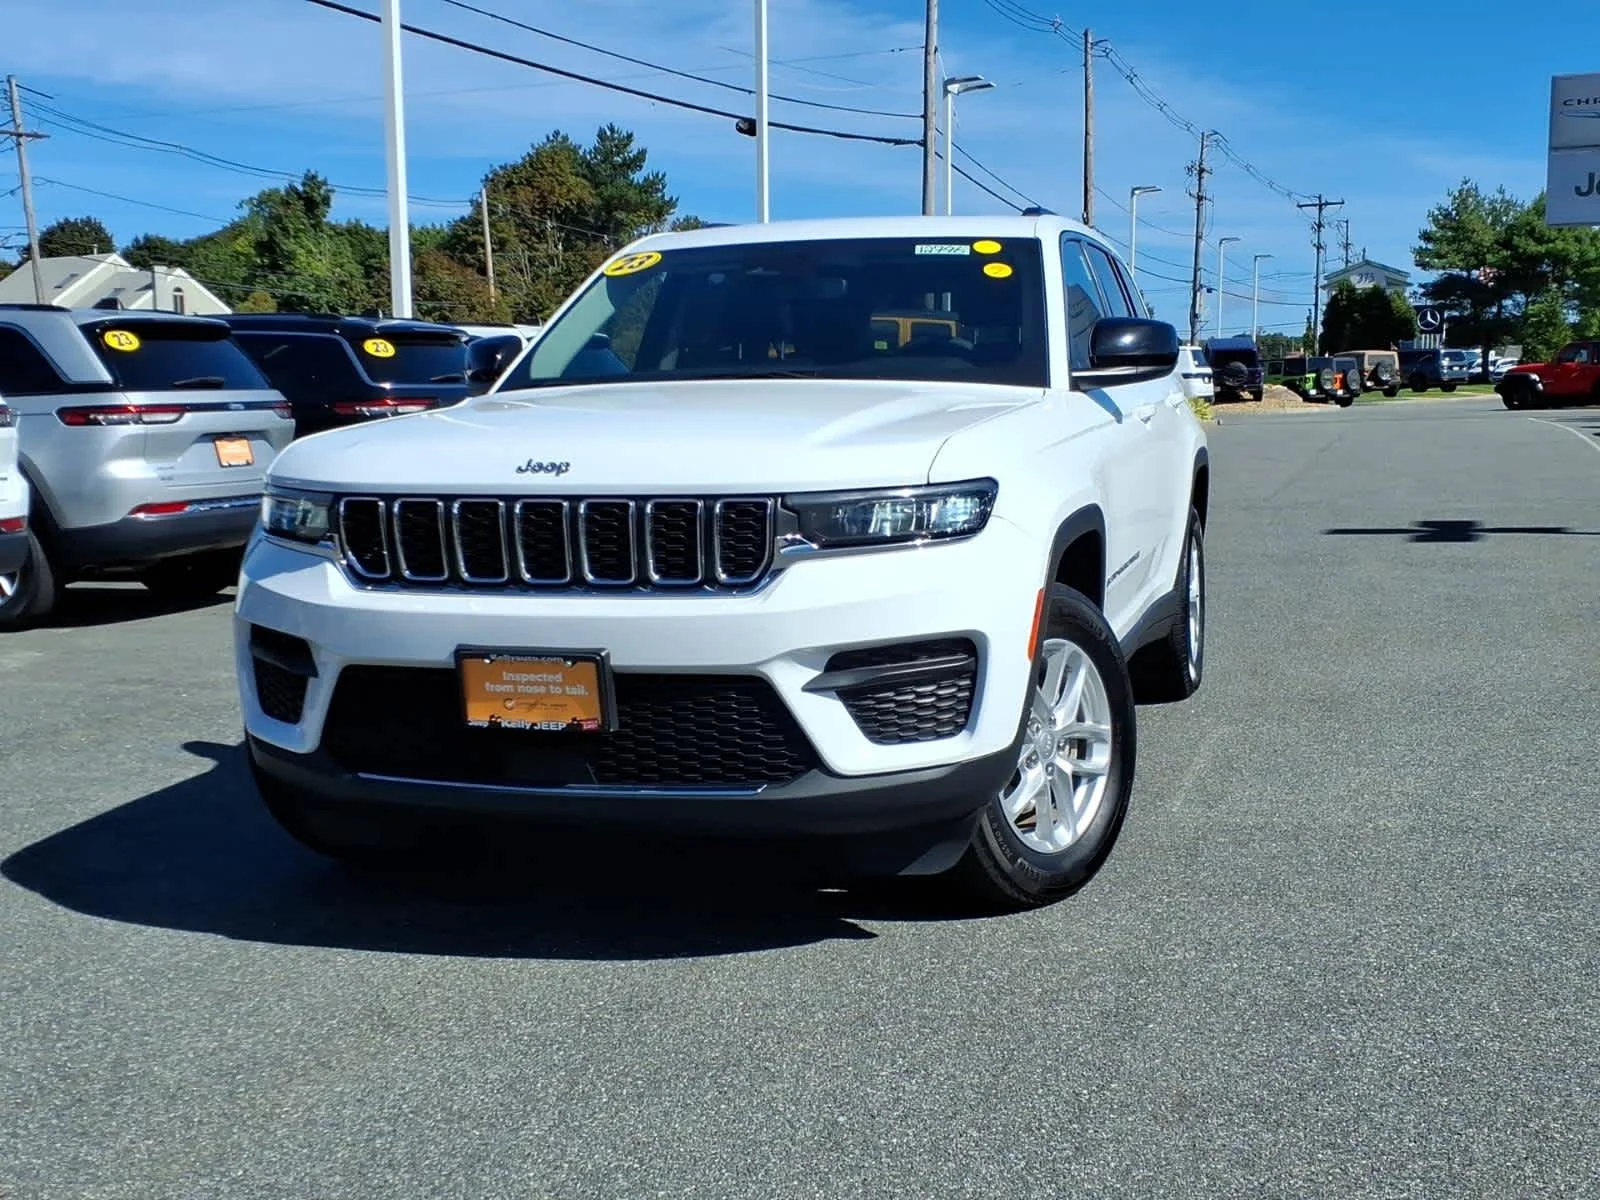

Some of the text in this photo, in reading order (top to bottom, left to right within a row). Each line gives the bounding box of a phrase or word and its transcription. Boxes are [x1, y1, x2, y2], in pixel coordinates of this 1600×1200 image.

[1574, 172, 1600, 197] J
[111, 332, 133, 346] 23
[371, 341, 389, 353] 23
[516, 458, 570, 477] Jeep
[502, 671, 563, 683] Inspected
[484, 682, 589, 696] from nose to tail.
[501, 719, 532, 730] Kelly
[534, 721, 567, 731] JEEP
